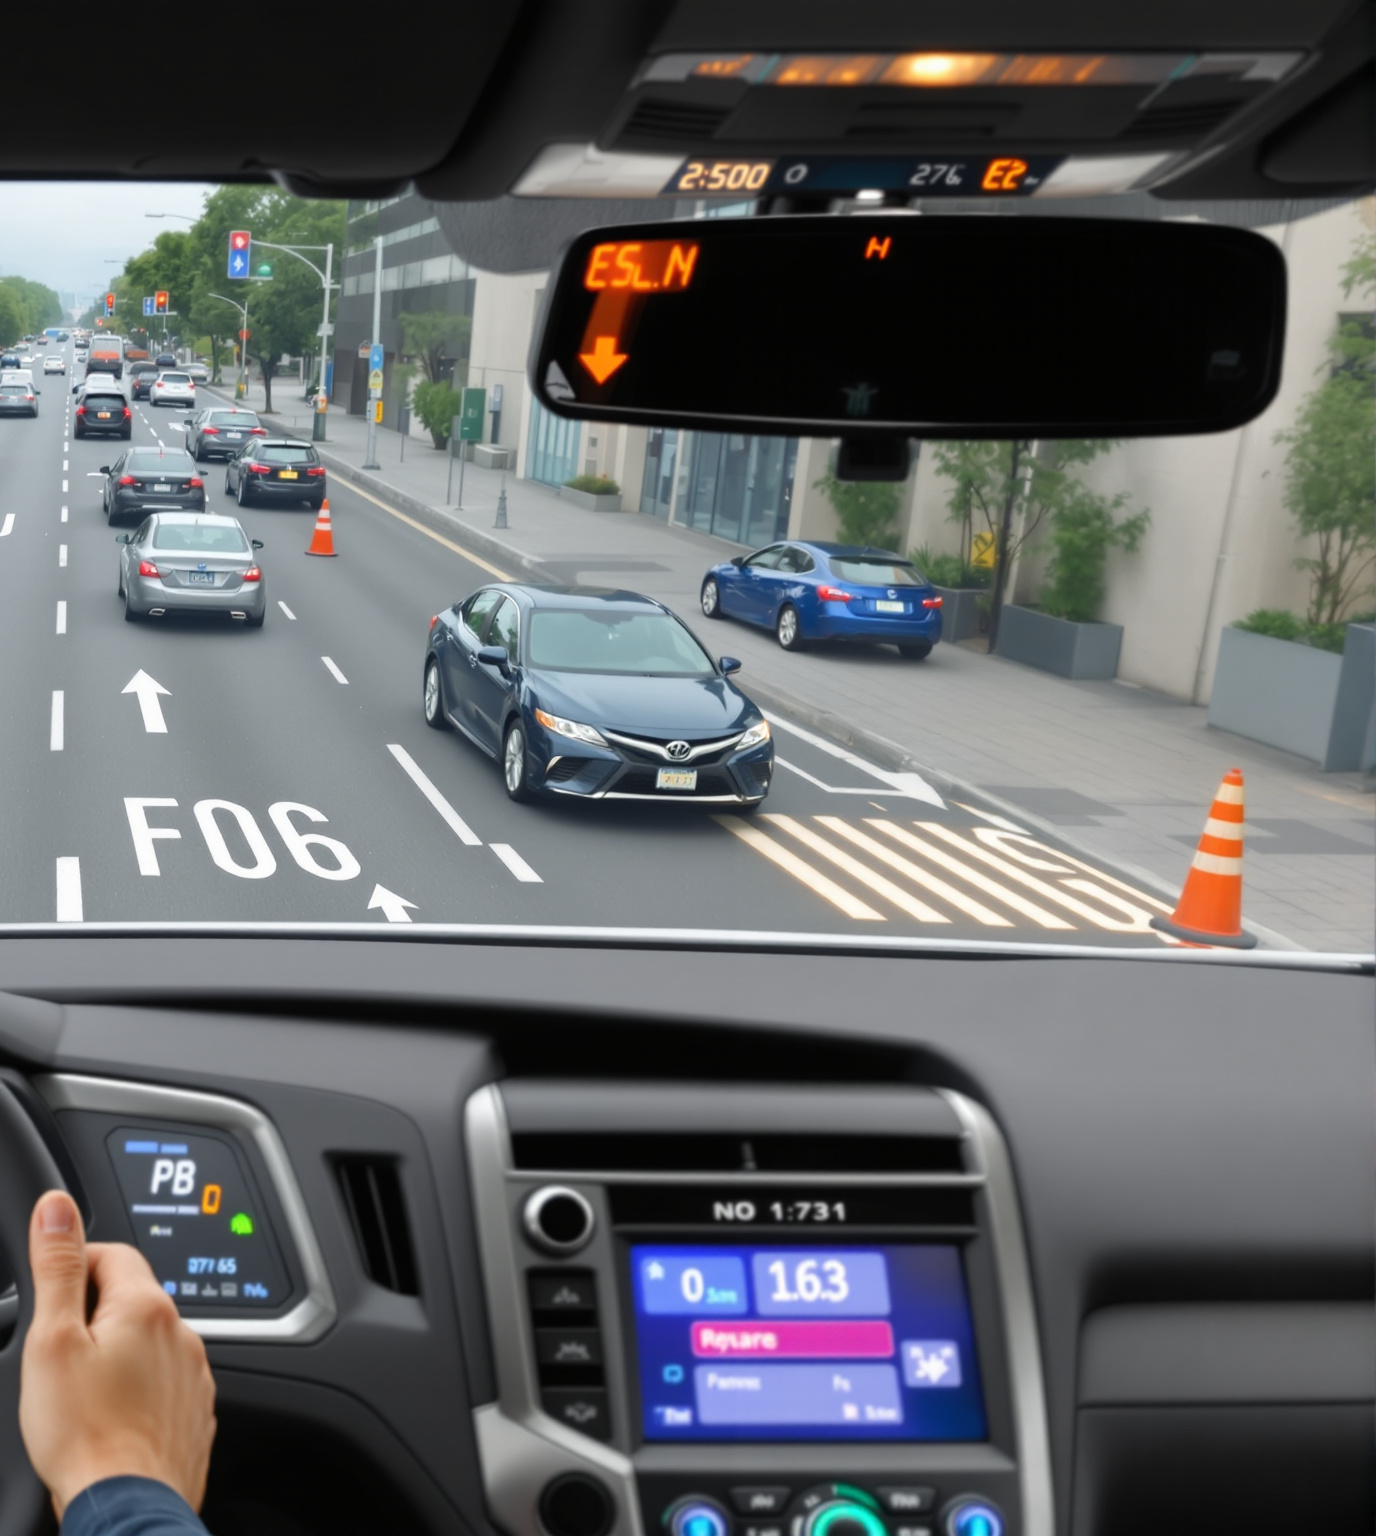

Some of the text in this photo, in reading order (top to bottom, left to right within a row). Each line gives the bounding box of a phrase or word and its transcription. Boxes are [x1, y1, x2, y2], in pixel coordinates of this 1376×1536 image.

[150, 1159, 197, 1195] PB
[712, 1201, 845, 1222] NO 1:731
